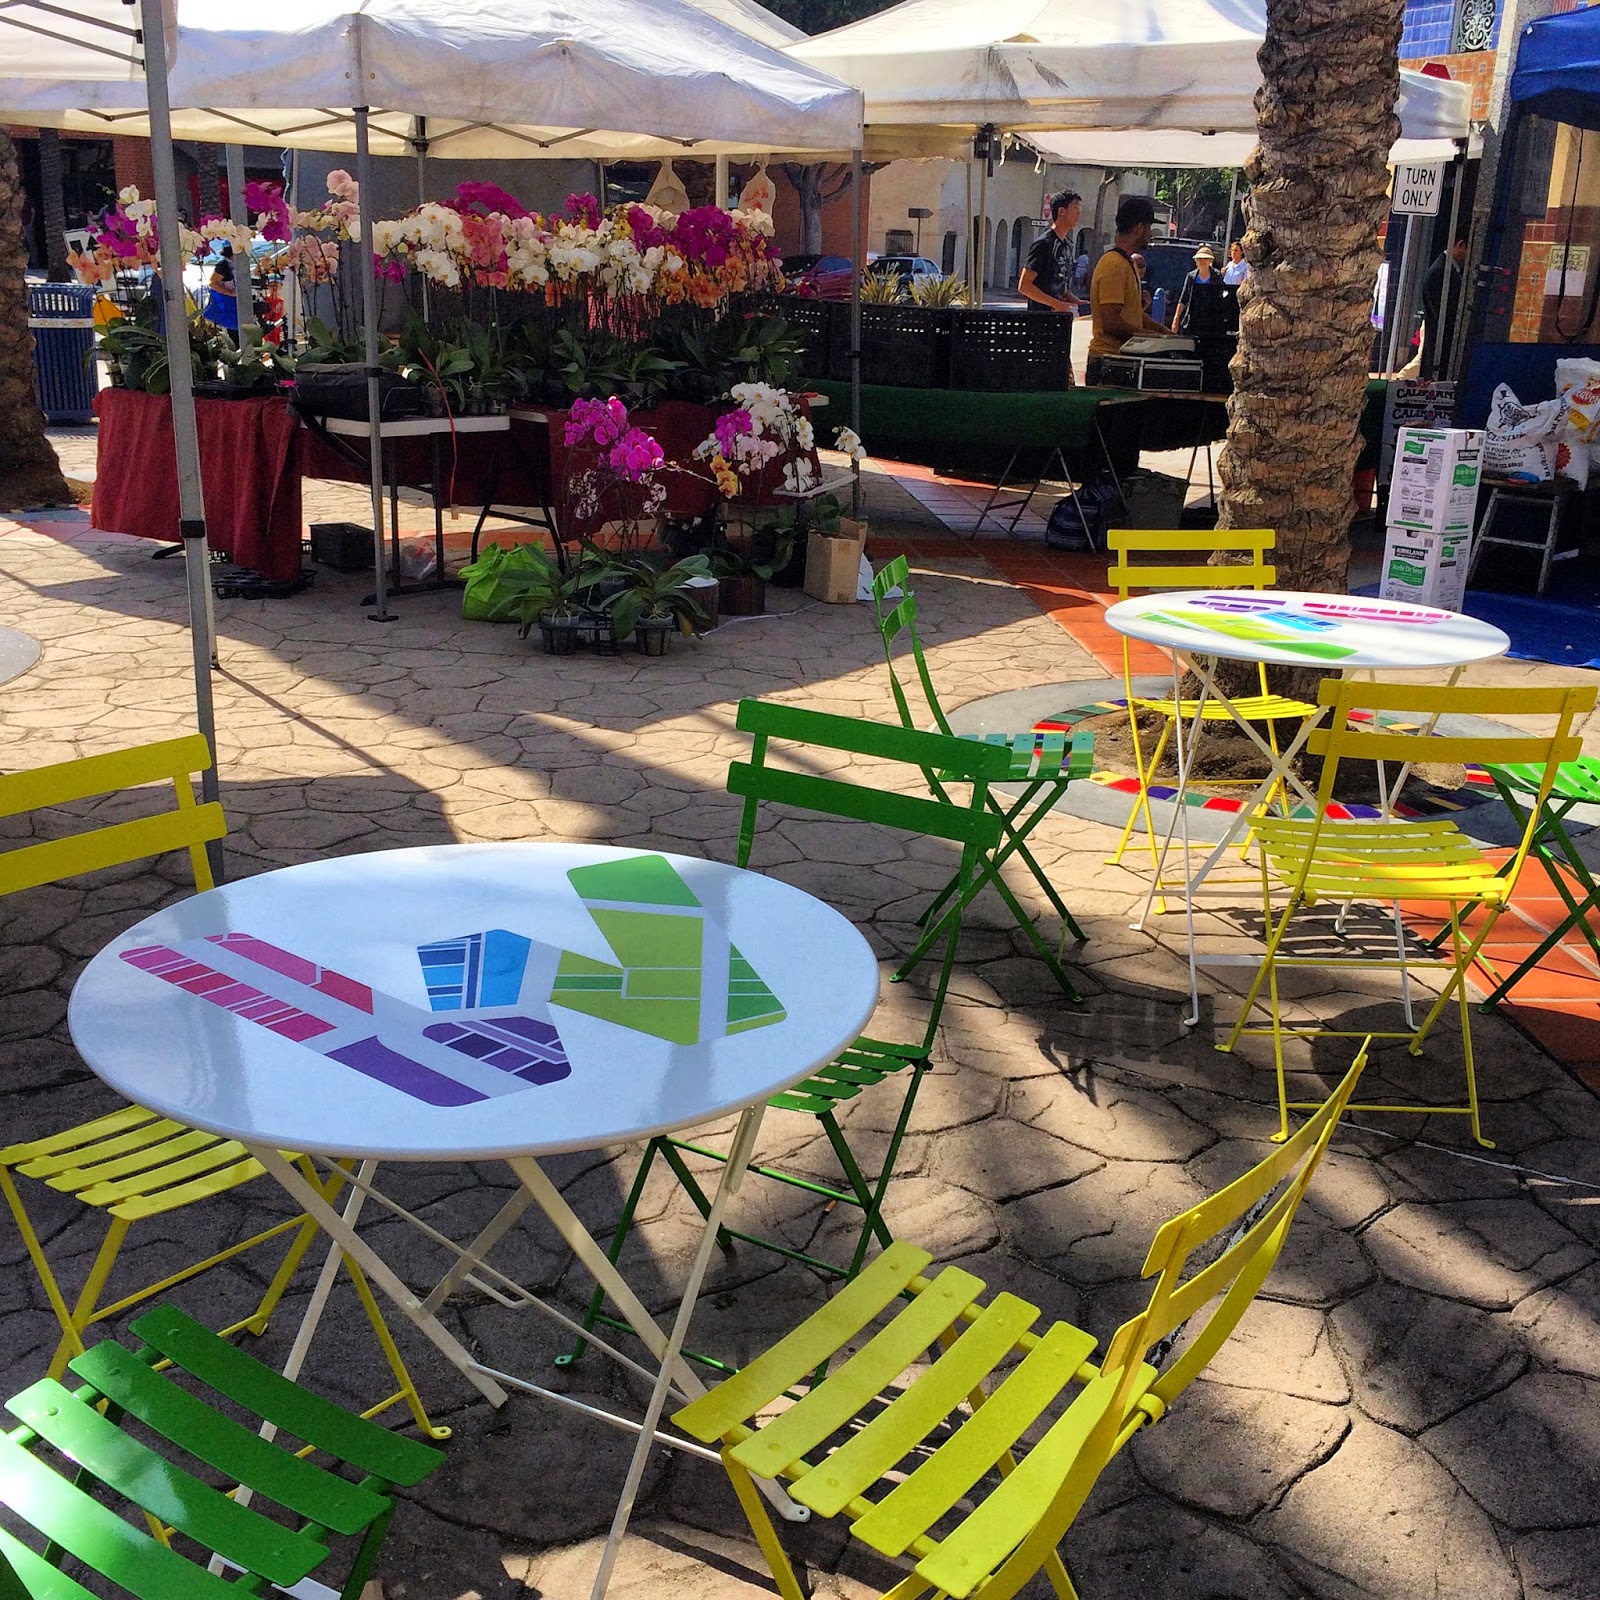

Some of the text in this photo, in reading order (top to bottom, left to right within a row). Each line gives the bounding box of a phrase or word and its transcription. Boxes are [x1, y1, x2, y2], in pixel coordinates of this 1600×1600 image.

[1406, 166, 1436, 186] TURN
[1402, 189, 1432, 208] ONLY
[1396, 548, 1424, 557] KIRKLAND
